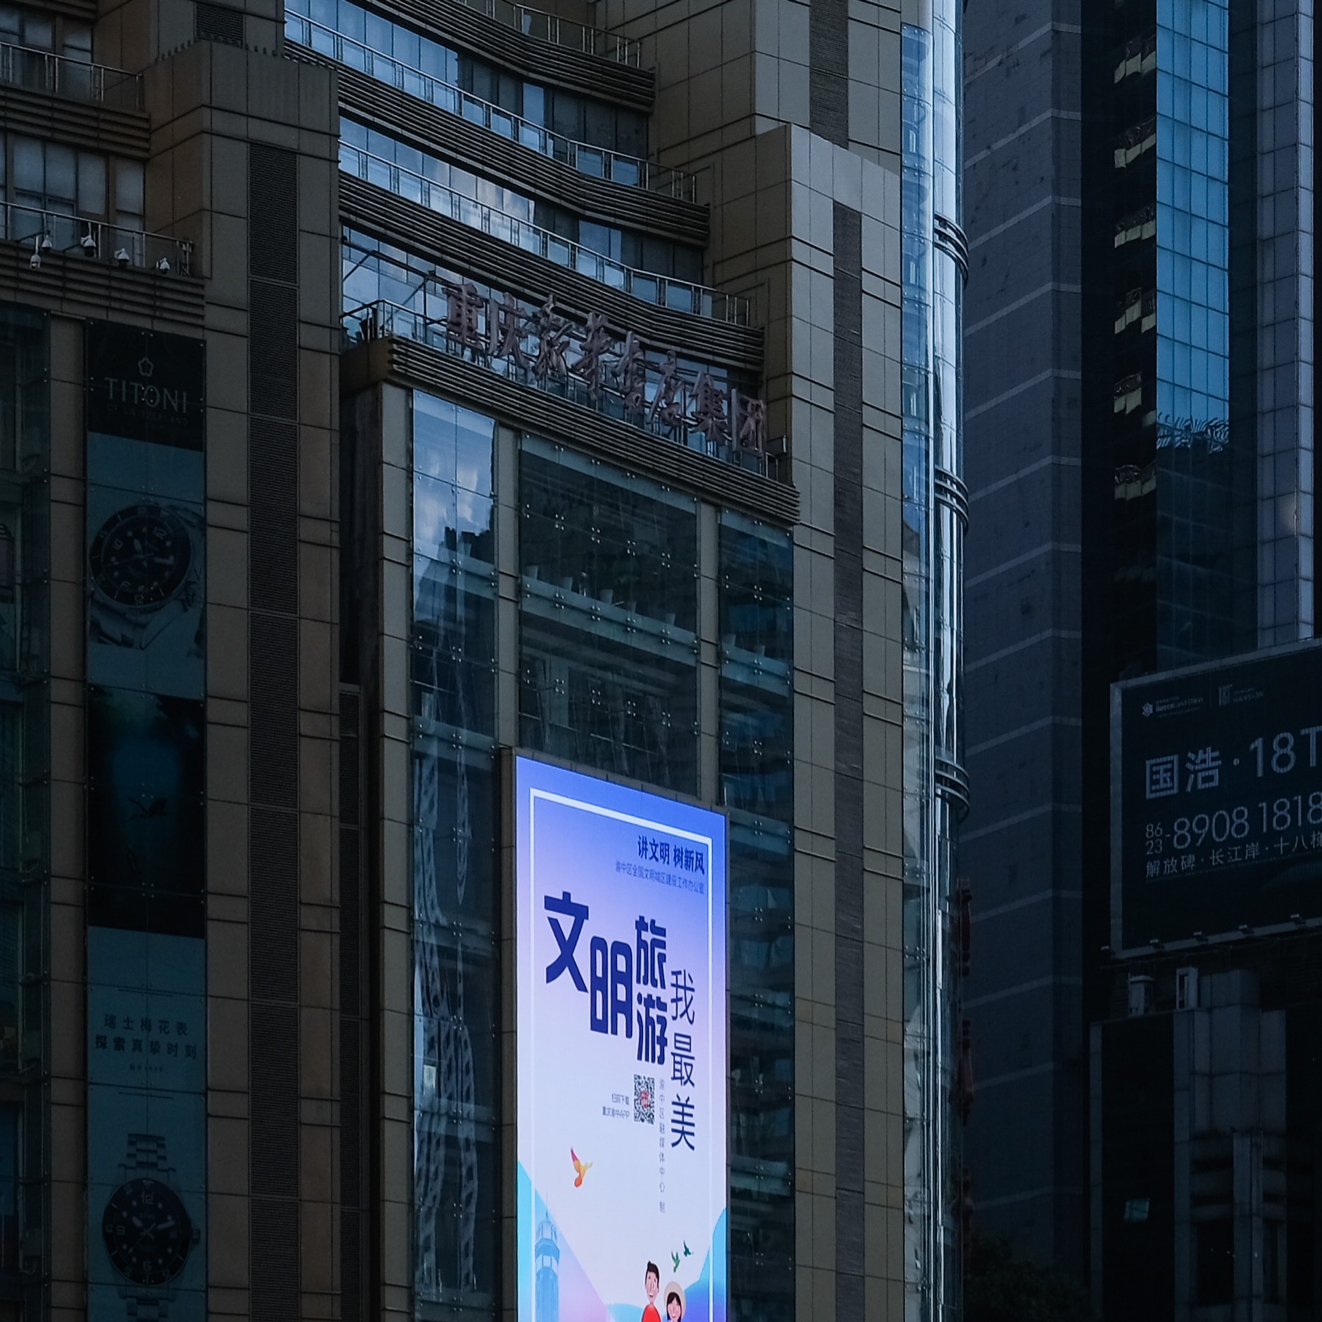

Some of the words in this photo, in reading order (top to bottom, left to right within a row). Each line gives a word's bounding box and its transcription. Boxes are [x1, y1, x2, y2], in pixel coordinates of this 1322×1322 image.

[105, 377, 187, 414] TITONI
[638, 835, 669, 865] 讲文明
[673, 845, 705, 875] 树新风
[104, 1013, 188, 1037] 瑞士梅花表
[670, 967, 696, 1151] 我最美
